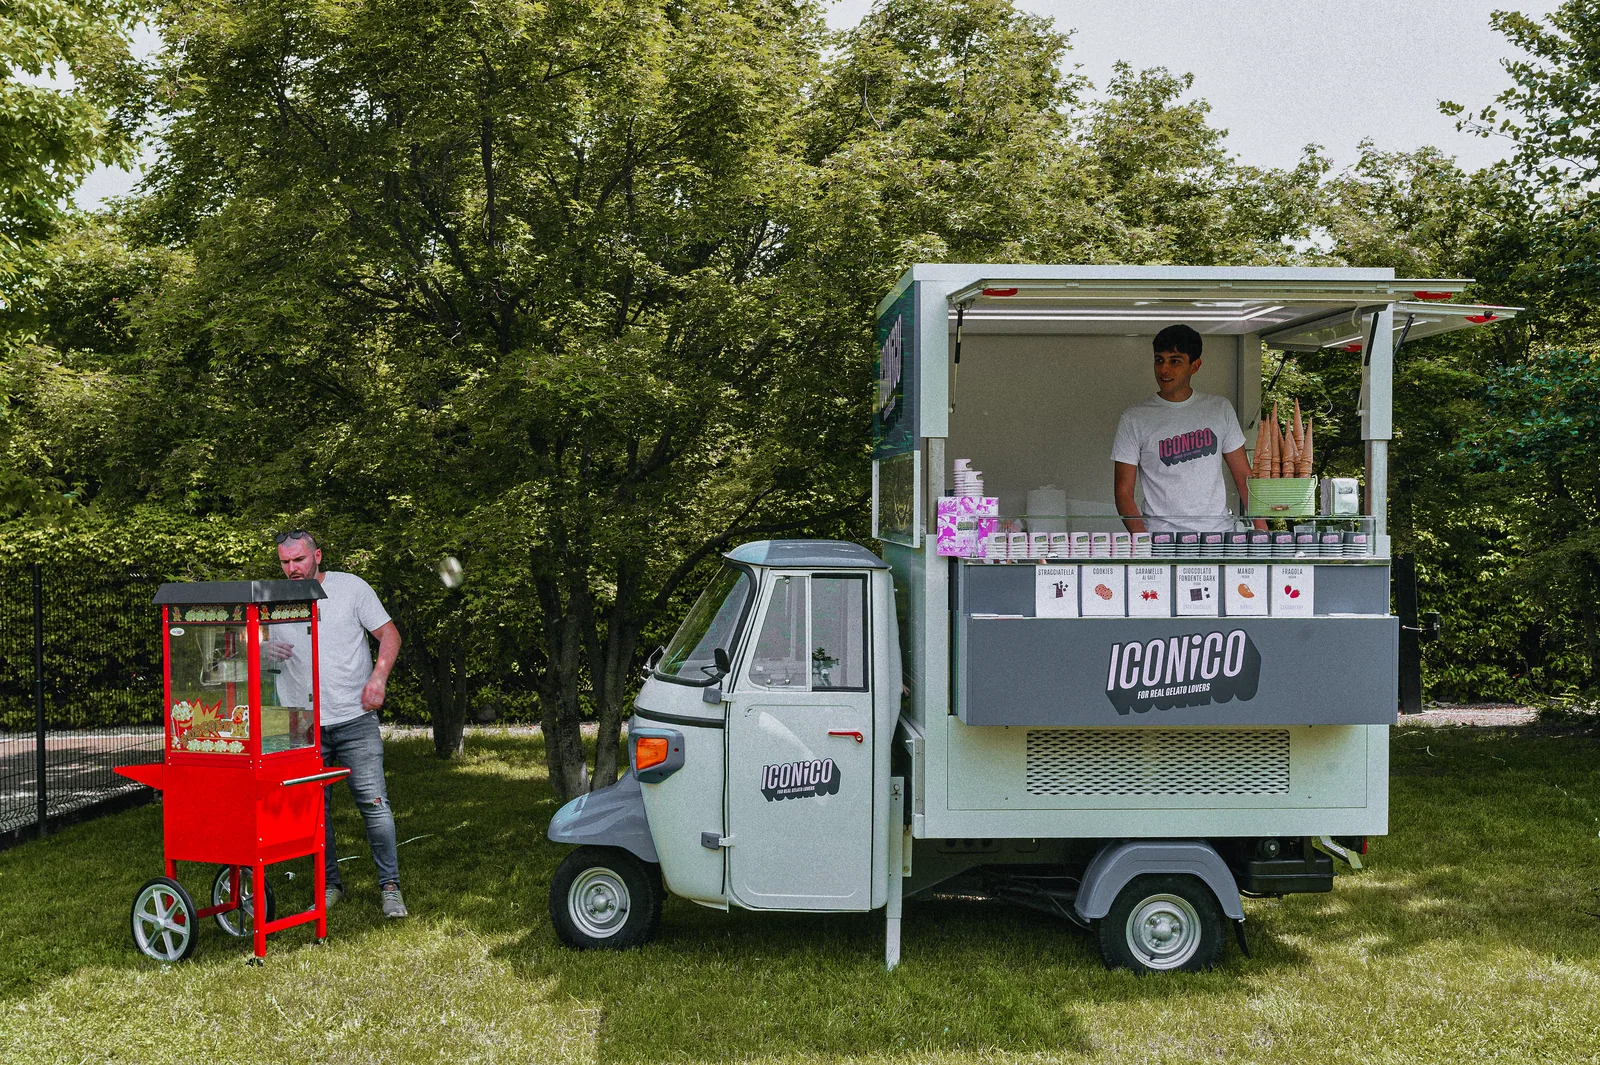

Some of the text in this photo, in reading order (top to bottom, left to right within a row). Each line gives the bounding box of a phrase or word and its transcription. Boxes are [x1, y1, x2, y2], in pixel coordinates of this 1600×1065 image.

[1237, 567, 1255, 575] MANGO
[1178, 574, 1216, 582] FONDENTE DARK
[1137, 682, 1211, 700] FOR REAL GELATO LOVERS
